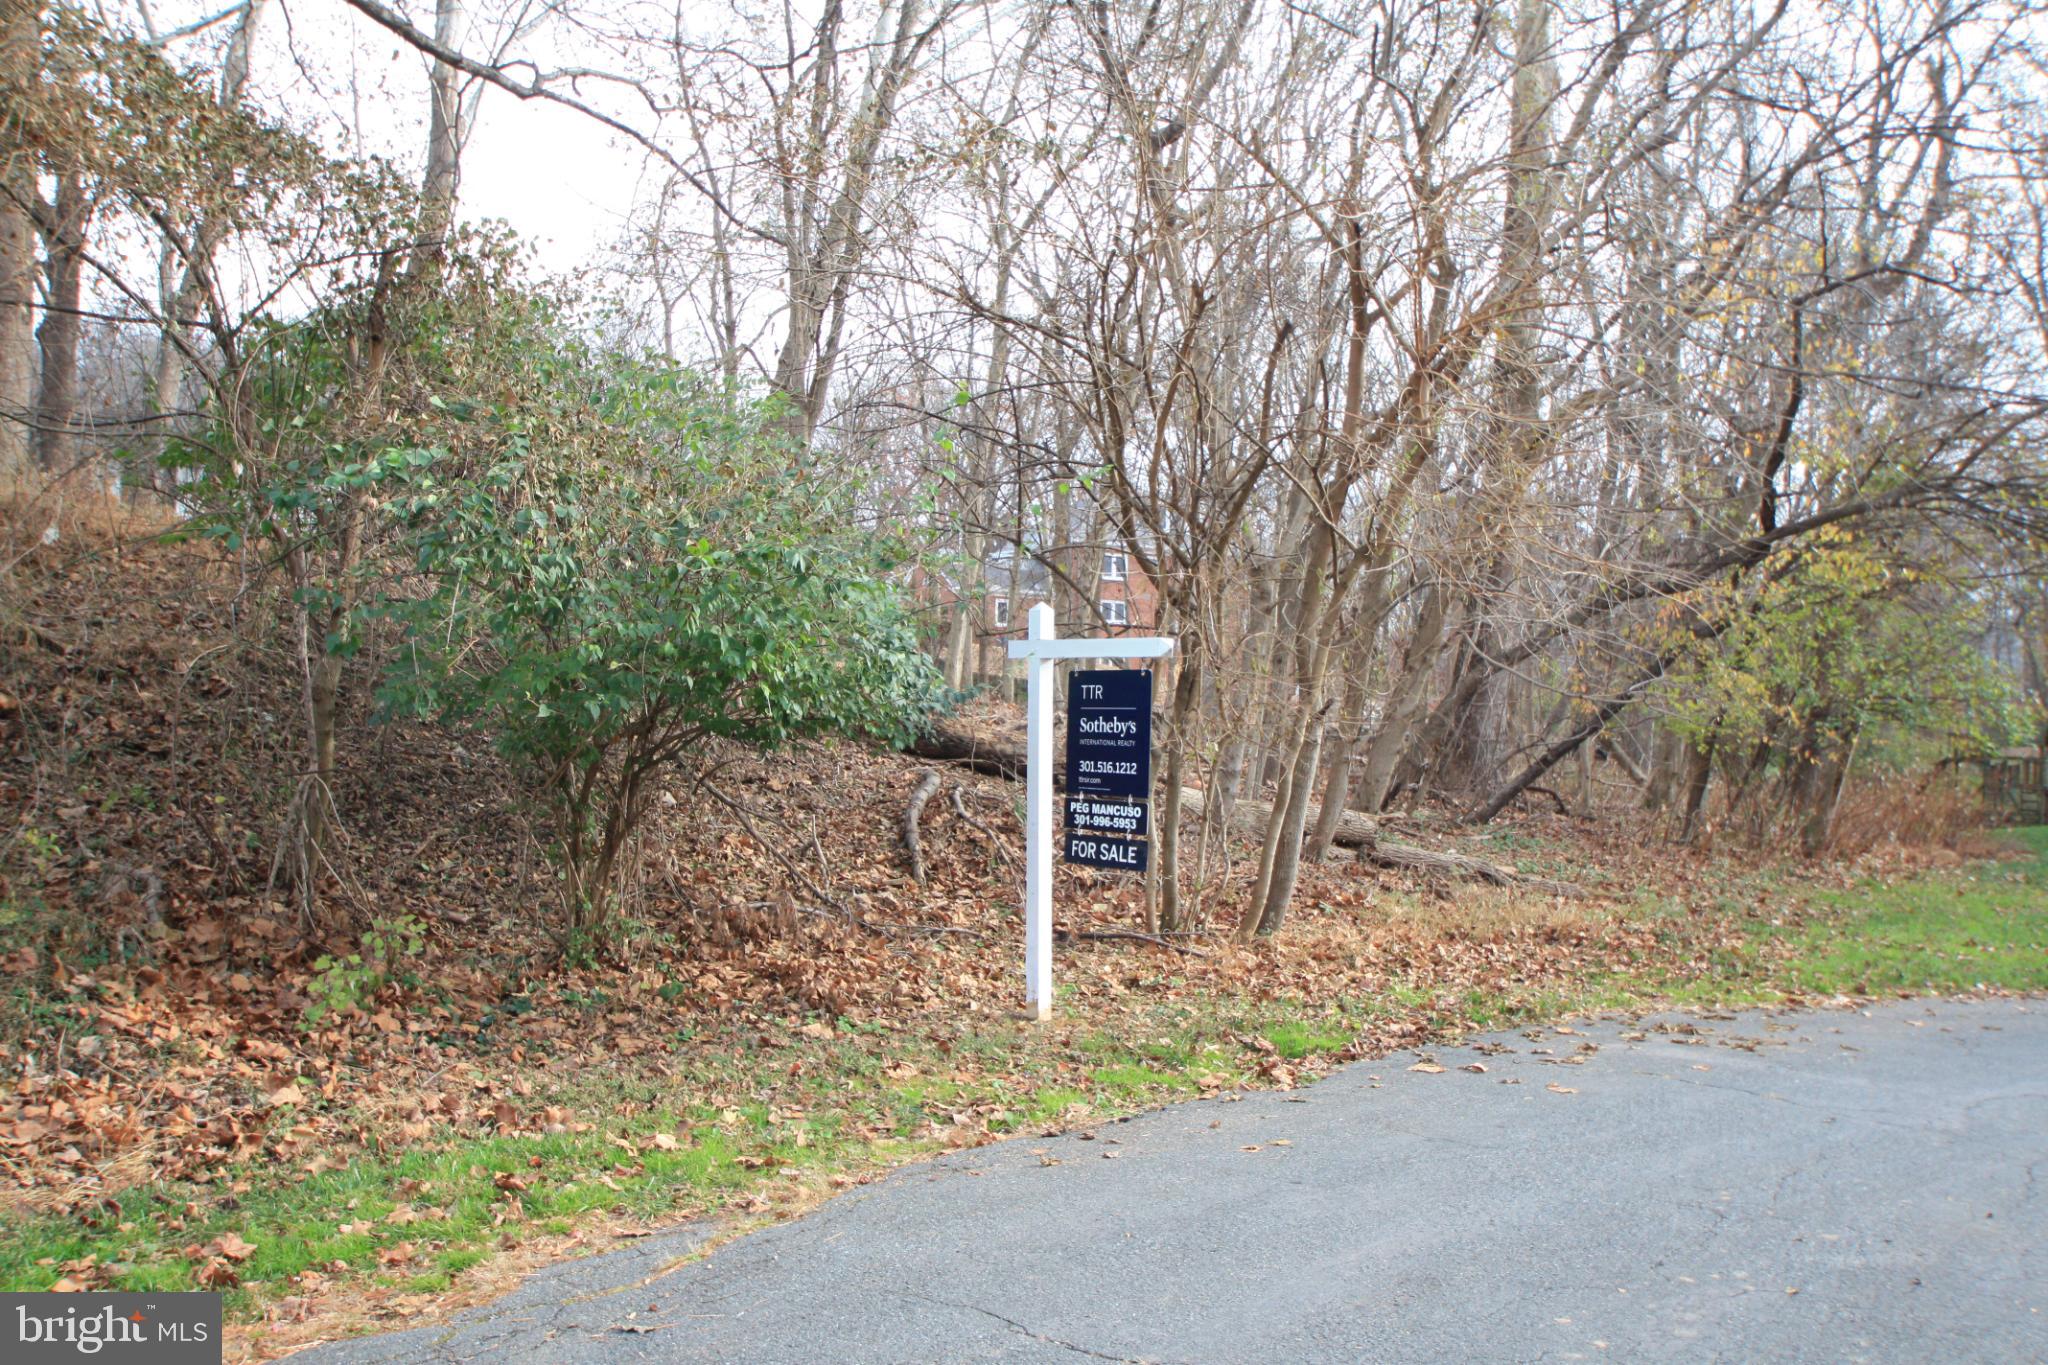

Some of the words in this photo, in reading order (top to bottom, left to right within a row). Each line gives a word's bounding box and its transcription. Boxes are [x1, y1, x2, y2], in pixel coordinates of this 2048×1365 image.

[1081, 685, 1103, 699] TTR
[1080, 716, 1136, 737] Sotheby's
[1079, 738, 1116, 746] INTERNATIONAL
[1117, 739, 1136, 747] REALTY
[1079, 760, 1137, 774] 301.516.1212
[1070, 801, 1089, 813] PEG
[1092, 803, 1141, 818] MANCUSO
[1074, 814, 1137, 829] 301-996-5953
[1071, 840, 1096, 859] FOR
[1099, 843, 1138, 864] SALE
